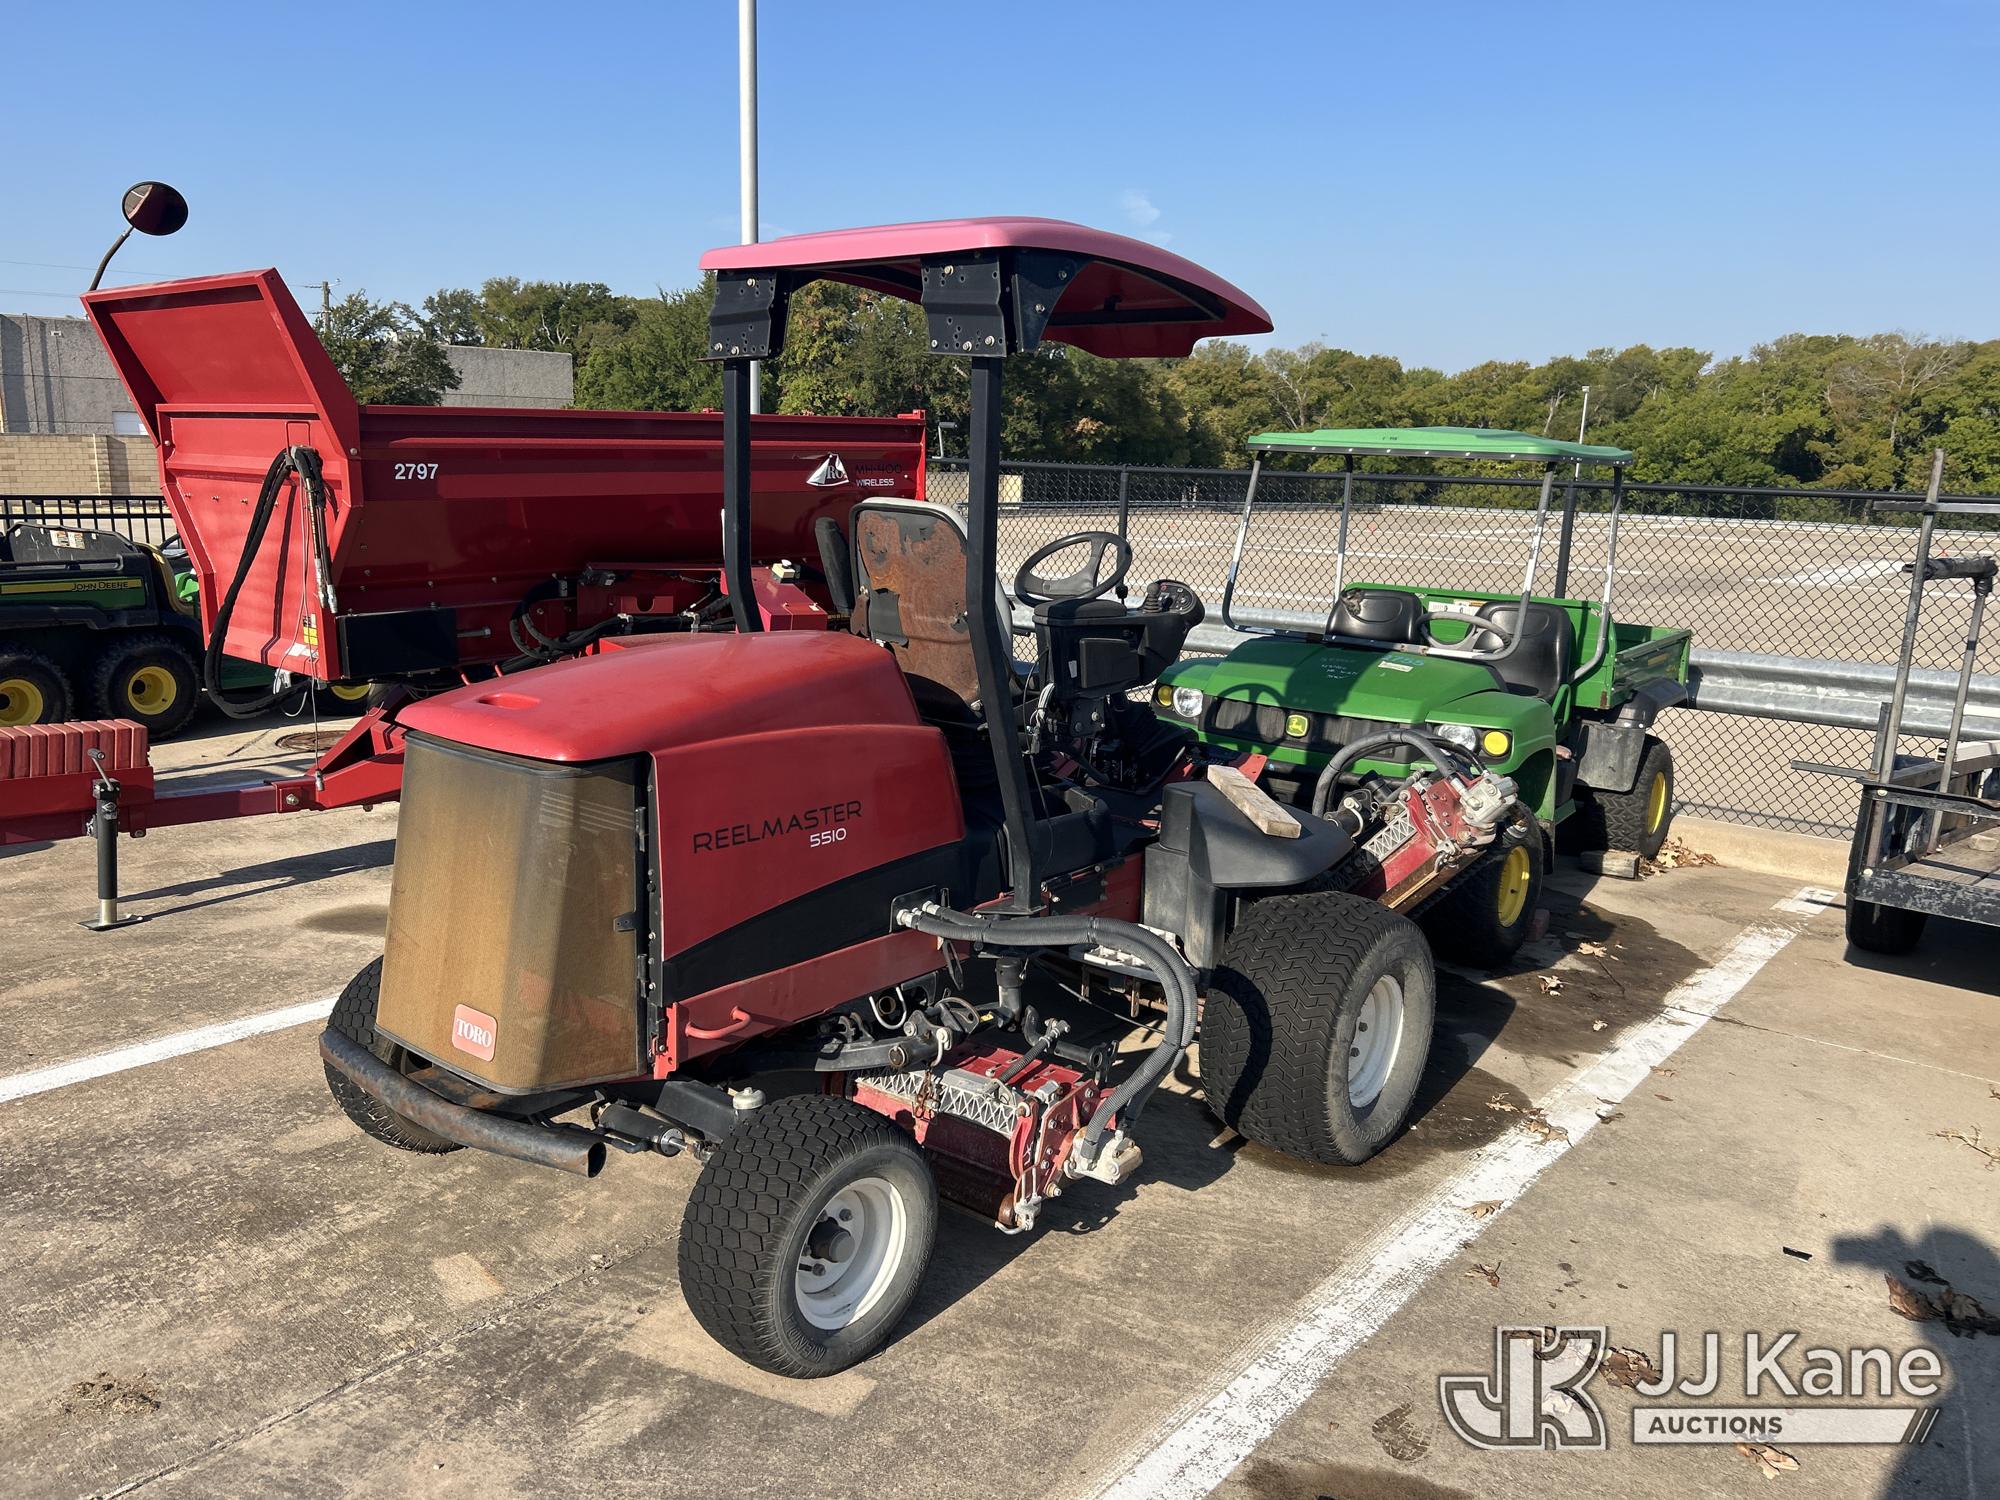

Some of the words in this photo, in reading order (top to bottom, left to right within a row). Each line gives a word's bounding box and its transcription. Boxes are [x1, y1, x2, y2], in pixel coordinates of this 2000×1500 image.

[394, 463, 439, 480] 2797
[856, 478, 895, 487] WIRELESS
[72, 583, 97, 591] JOHN
[98, 581, 129, 589] DEERE
[693, 799, 862, 854] REELMASTER
[809, 827, 847, 848] 5510
[456, 1018, 492, 1048] TORO
